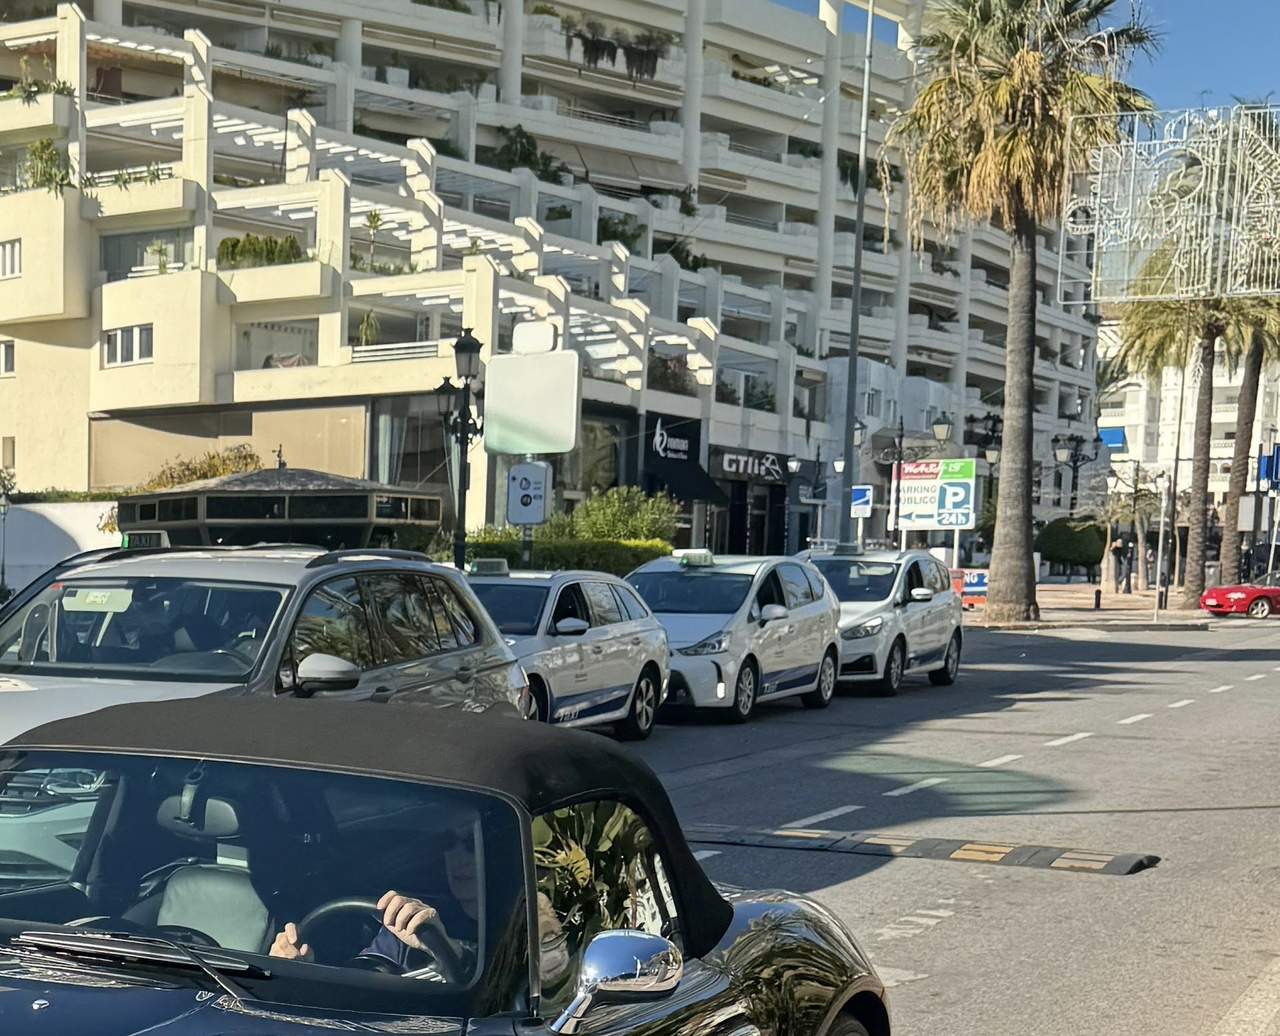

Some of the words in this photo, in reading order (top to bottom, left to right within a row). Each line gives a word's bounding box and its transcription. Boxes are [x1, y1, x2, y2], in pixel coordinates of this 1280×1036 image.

[898, 485, 937, 494] ARKING
[898, 495, 937, 505] BLICO
[941, 513, 966, 525] 24h
